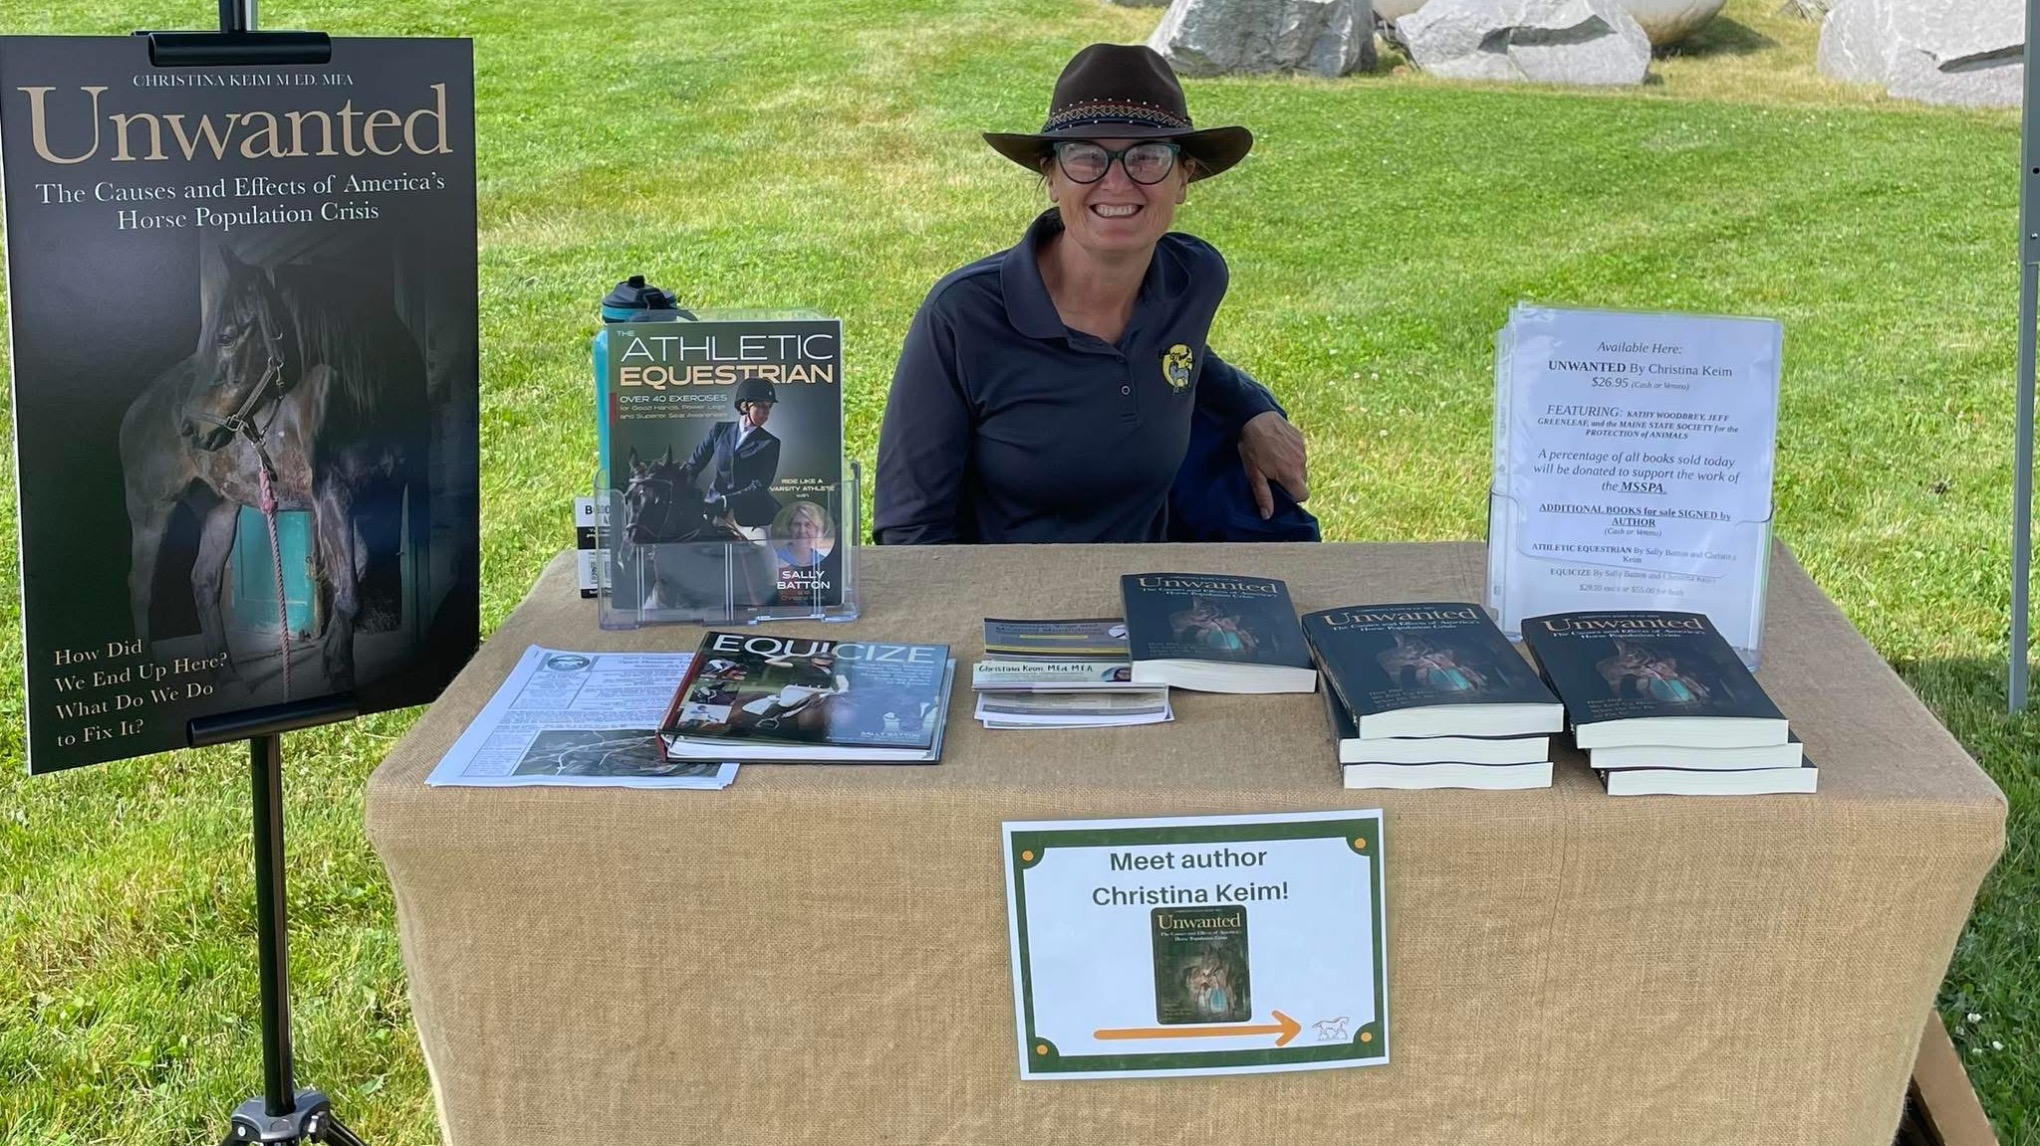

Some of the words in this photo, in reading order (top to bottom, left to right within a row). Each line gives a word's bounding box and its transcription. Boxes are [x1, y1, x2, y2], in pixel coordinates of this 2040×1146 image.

[132, 74, 226, 87] CHRISTINA
[229, 74, 271, 87] KEIM
[276, 74, 289, 86] M
[17, 83, 453, 165] Unwanted
[35, 183, 86, 205] The
[94, 180, 176, 203] Causes
[184, 178, 226, 199] and
[234, 176, 306, 198] Effects
[313, 173, 337, 194] of
[343, 171, 446, 194] America's
[117, 209, 187, 230] Horse
[195, 204, 313, 232] Population
[320, 201, 380, 221] Crisis
[620, 334, 833, 362] ATHLETIC
[1597, 341, 1650, 354] Available
[1652, 343, 1683, 355] Here:
[620, 363, 833, 390] EQUESTRIAN
[1548, 360, 1626, 373] UNWANTED
[1629, 363, 1646, 376] By
[1648, 363, 1698, 376] Christina
[1702, 365, 1733, 377] Keim
[1591, 376, 1629, 389] $26.95
[620, 395, 650, 403] OVER
[652, 395, 667, 403] 40
[669, 394, 728, 402] EXERCISES
[1547, 404, 1624, 418] FEATURING:
[1627, 411, 1655, 419] KATHY
[1707, 414, 1730, 422] JEFF
[1585, 429, 1639, 438] PROTECTION
[1640, 430, 1649, 439] of
[1649, 431, 1689, 440] ANIMALS
[1591, 420, 1605, 428] and
[1606, 420, 1618, 428] the
[1619, 421, 1647, 429] MAINE
[1649, 422, 1675, 430] STATE
[1676, 422, 1713, 432] SOCIETY
[1714, 424, 1726, 433] for
[1727, 425, 1739, 433] the
[1538, 448, 1547, 459] A
[1549, 450, 1610, 464] percentage
[1611, 450, 1625, 464] of
[1625, 451, 1640, 462] all
[1642, 452, 1675, 464] books
[1677, 454, 1701, 465] sold
[1703, 456, 1736, 470] today
[1533, 463, 1554, 474] will
[1557, 464, 1570, 475] be
[1572, 464, 1616, 477] donated
[1618, 467, 1630, 477] to
[1632, 467, 1674, 481] support
[1676, 469, 1694, 480] the
[1697, 470, 1725, 482] work
[1728, 471, 1741, 484] of
[1601, 481, 1619, 491] the
[1539, 503, 1601, 514] ADDITIONAL
[1606, 505, 1642, 515] BOOKS
[1643, 507, 1657, 516] for
[1659, 508, 1676, 517] sale
[1678, 509, 1718, 519] SIGNED
[1720, 511, 1731, 521] by
[1611, 517, 1657, 527] AUTHOR
[1531, 543, 1576, 553] ATHLETIC
[1577, 545, 1632, 554] EQUESTRIAN
[1633, 546, 1644, 557] By
[1645, 547, 1664, 558] Sally
[782, 570, 825, 579] SALLY
[1550, 567, 1592, 577] EQUICIZE
[776, 581, 830, 590] BATTON
[1138, 576, 1278, 594] Unwanted
[1324, 607, 1480, 626] Unwanted
[1542, 617, 1705, 633] Unwanted
[54, 649, 99, 666] How
[107, 638, 143, 659] Did
[712, 633, 936, 667] EQUICIZE
[54, 676, 86, 694] We
[93, 667, 132, 688] End
[139, 664, 167, 682] Up
[174, 651, 228, 674] Here?
[56, 701, 109, 720] What
[115, 694, 144, 711] Do
[151, 687, 180, 704] We
[186, 682, 214, 698] Do
[57, 733, 76, 747] to
[83, 726, 112, 743] Fix
[121, 718, 144, 737] It?
[1110, 851, 1175, 871] Meet
[1182, 847, 1268, 870] author
[1093, 884, 1208, 906] Christina
[1216, 881, 1289, 904] Keim!
[1157, 912, 1242, 930] Unwanted
